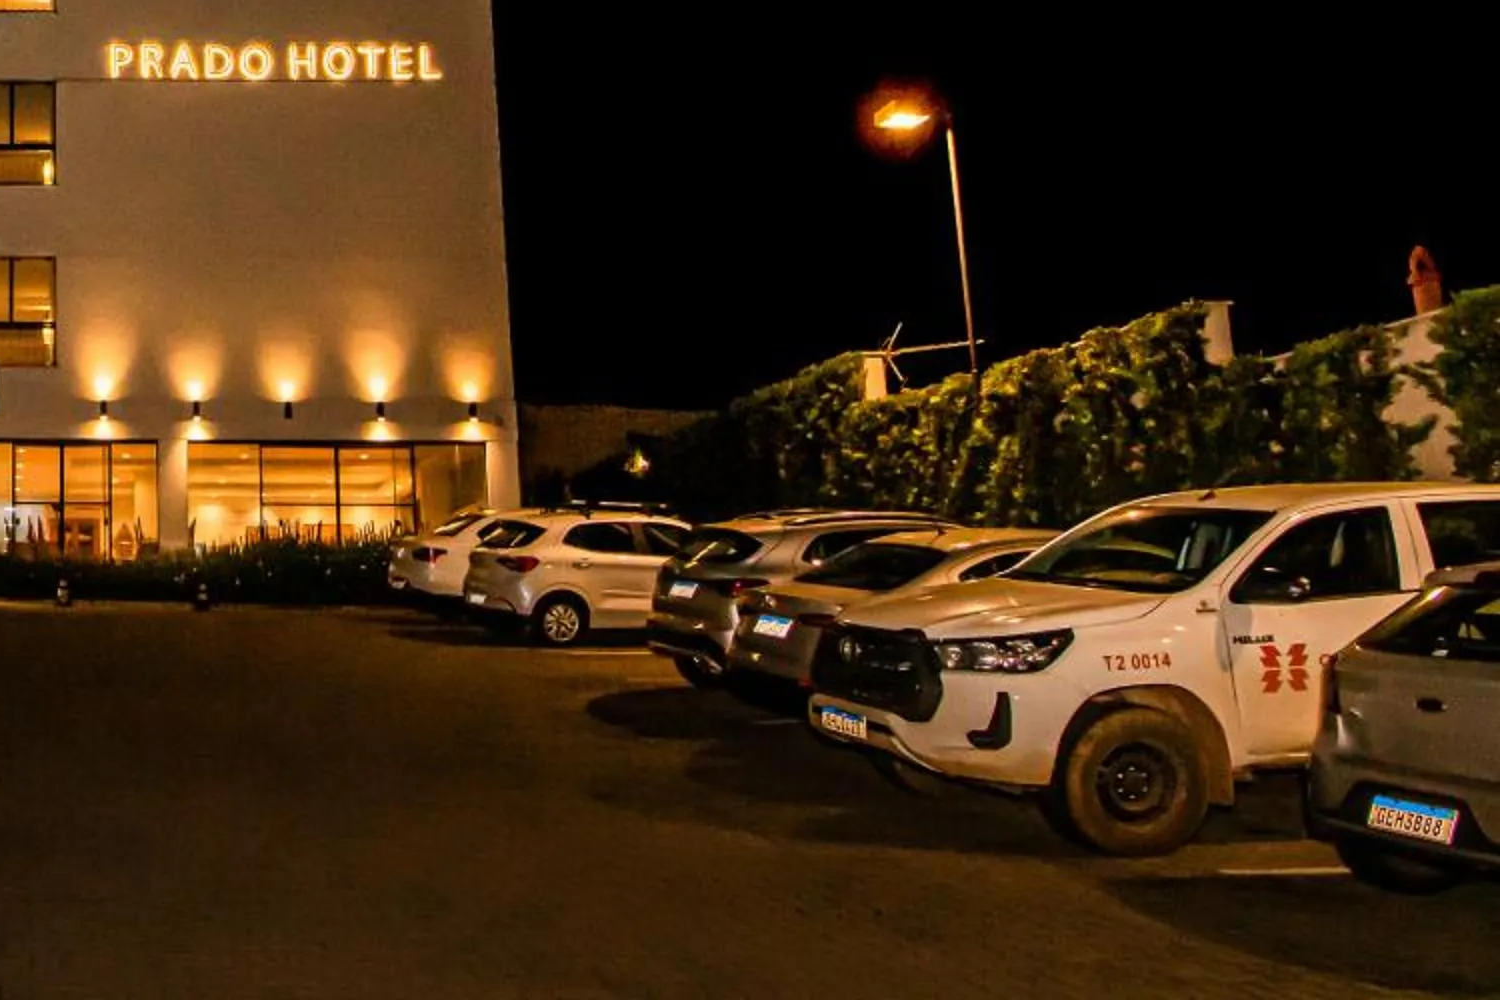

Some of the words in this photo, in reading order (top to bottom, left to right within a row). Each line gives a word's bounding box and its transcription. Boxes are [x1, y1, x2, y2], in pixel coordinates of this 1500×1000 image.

[107, 42, 272, 80] PRADO
[287, 42, 443, 81] HOTEL
[1102, 654, 1126, 672] T2
[1131, 652, 1172, 670] 0014
